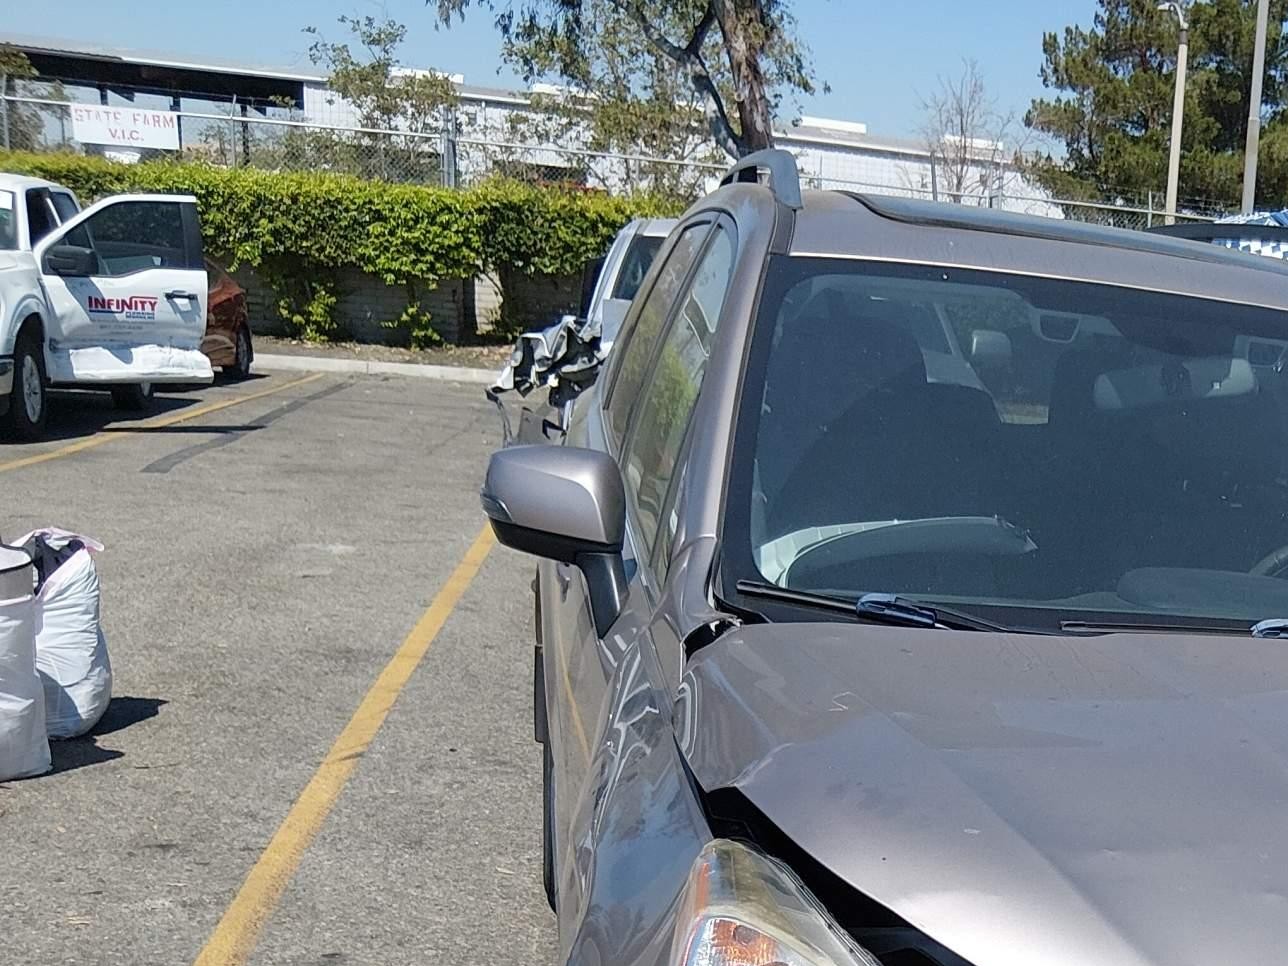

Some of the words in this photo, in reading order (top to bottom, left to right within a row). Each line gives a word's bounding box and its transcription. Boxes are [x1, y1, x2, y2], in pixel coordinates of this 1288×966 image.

[74, 108, 120, 121] STATE
[133, 113, 175, 128] FARM
[109, 128, 145, 141] V.I.C.
[88, 296, 158, 312] INFINITY
